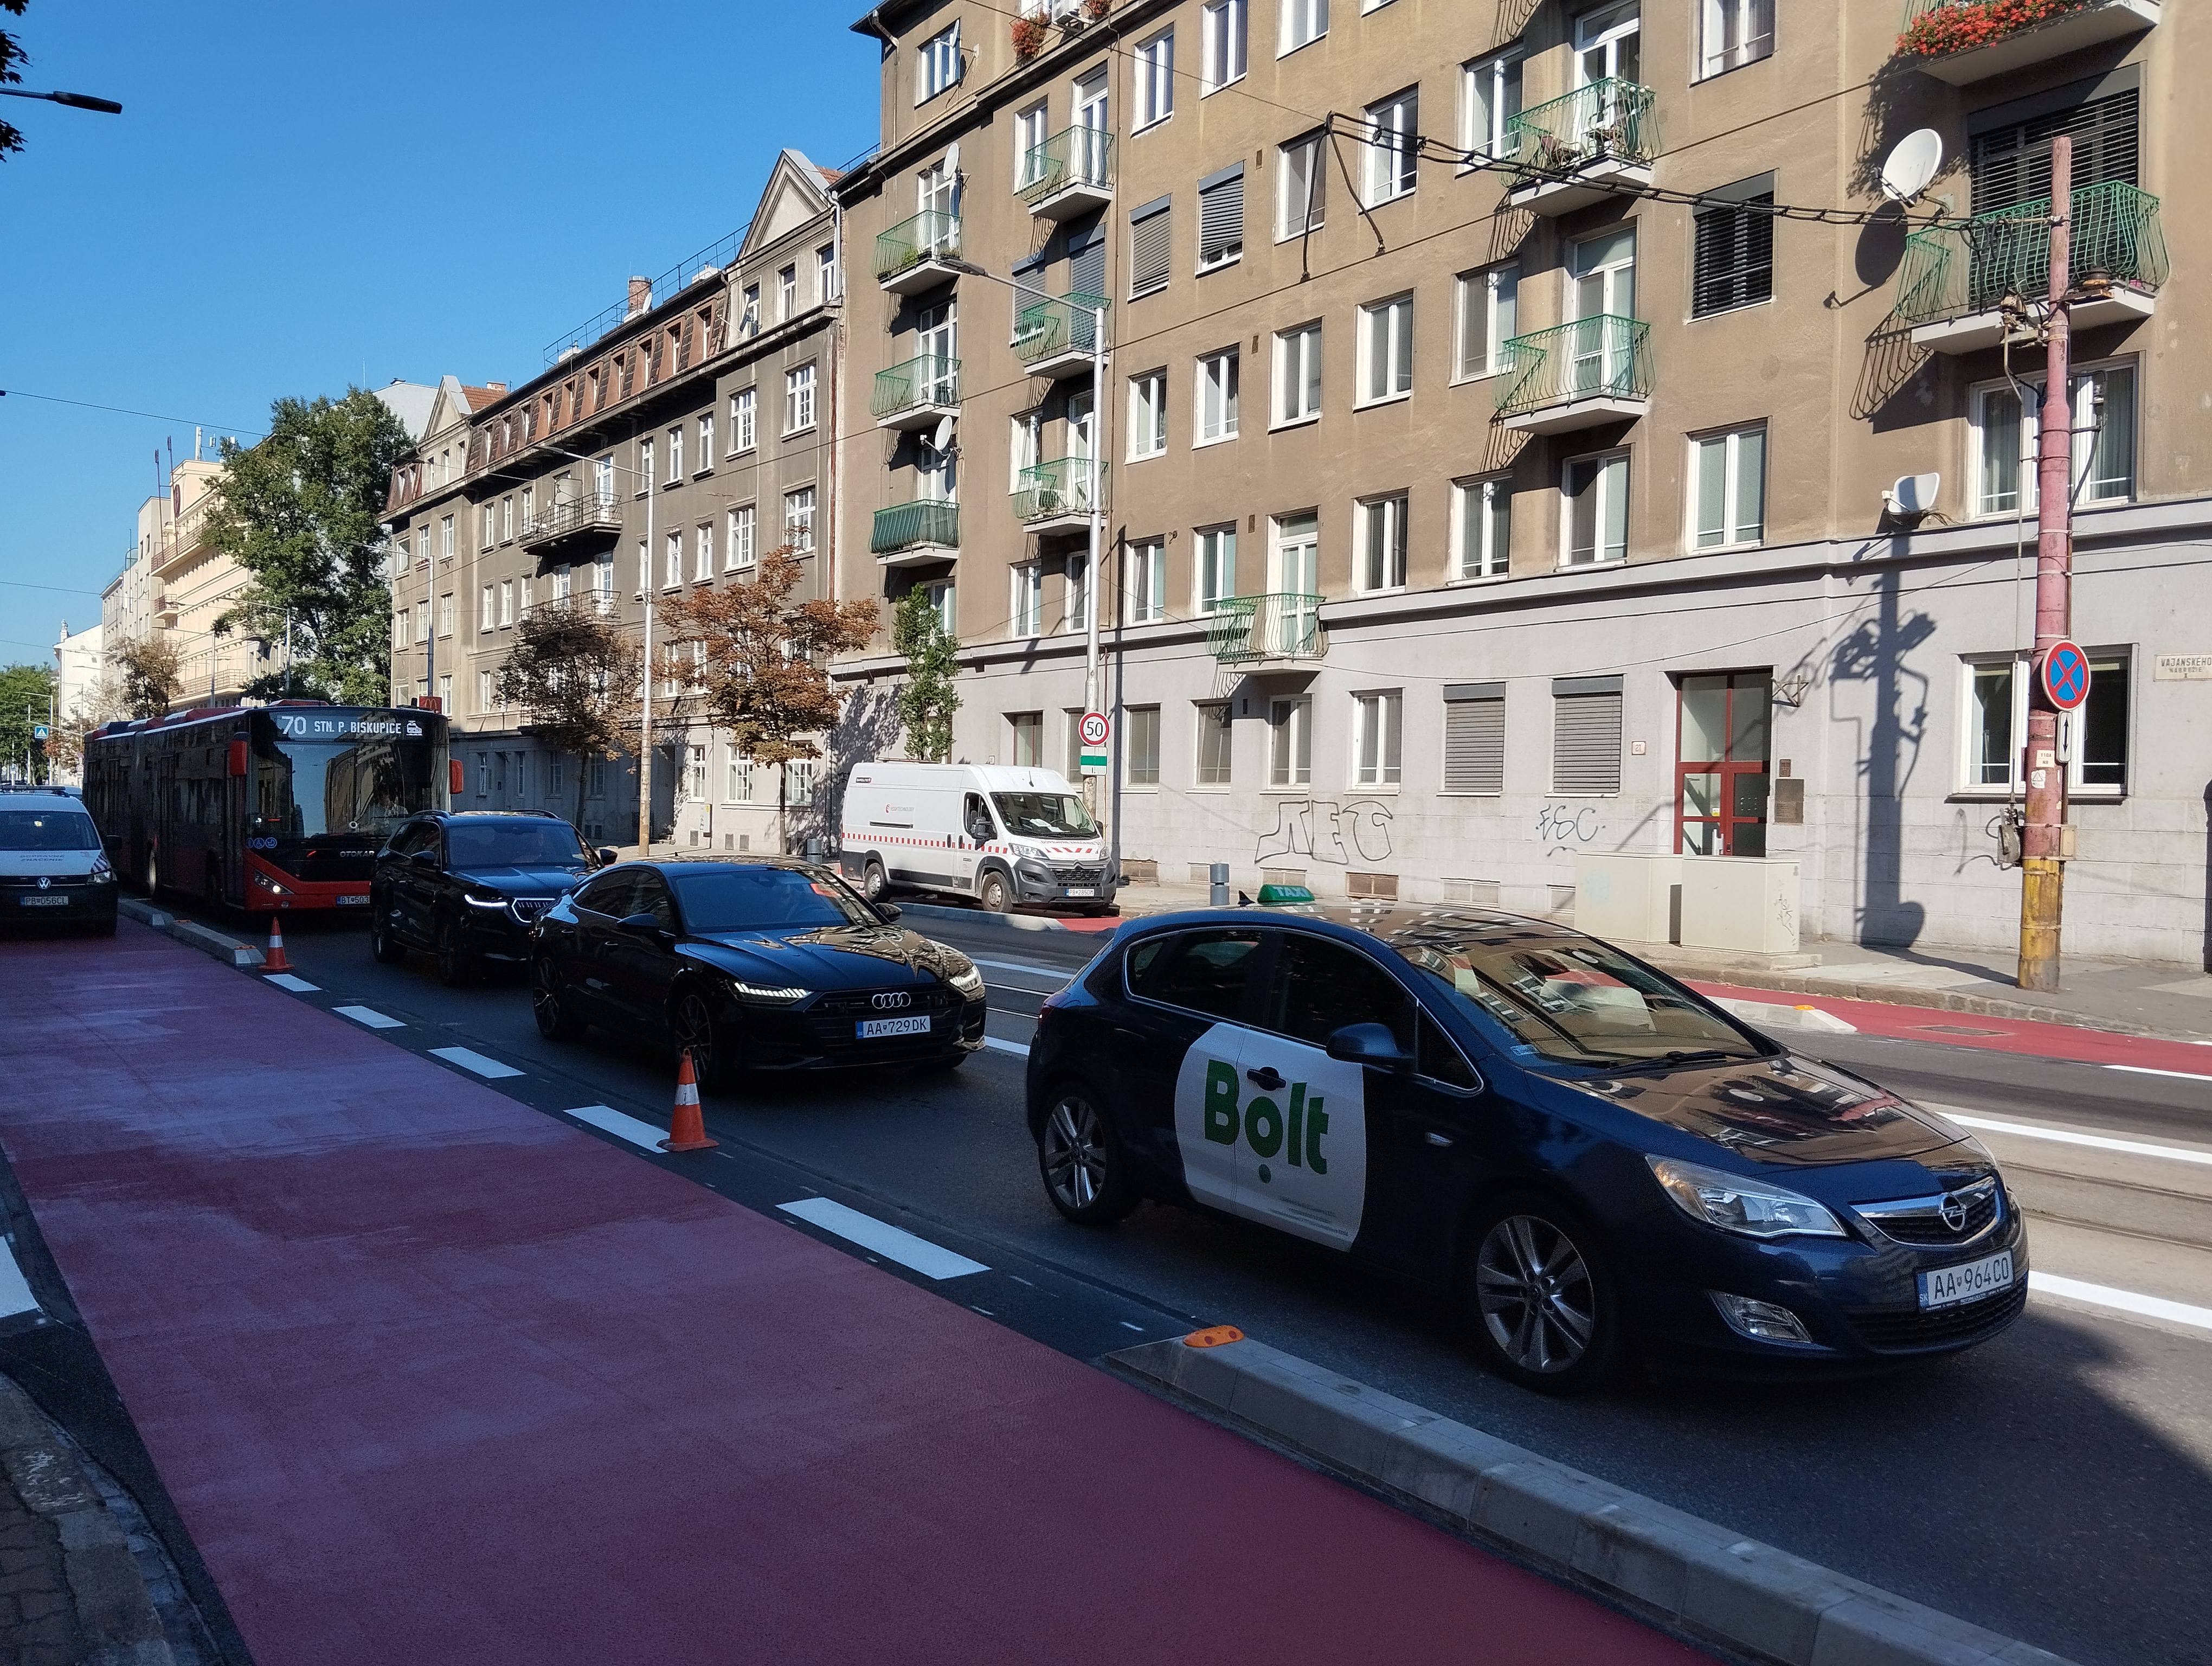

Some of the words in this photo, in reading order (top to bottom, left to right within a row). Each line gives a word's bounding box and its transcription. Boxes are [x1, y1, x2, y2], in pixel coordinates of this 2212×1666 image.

[281, 716, 307, 734] 70
[314, 721, 335, 733] STN.
[338, 721, 347, 733] P.
[350, 722, 402, 734] BISKUPICE
[1086, 721, 1103, 736] 50
[1272, 886, 1310, 897] TAXI
[1204, 1059, 1329, 1175] Bolt
